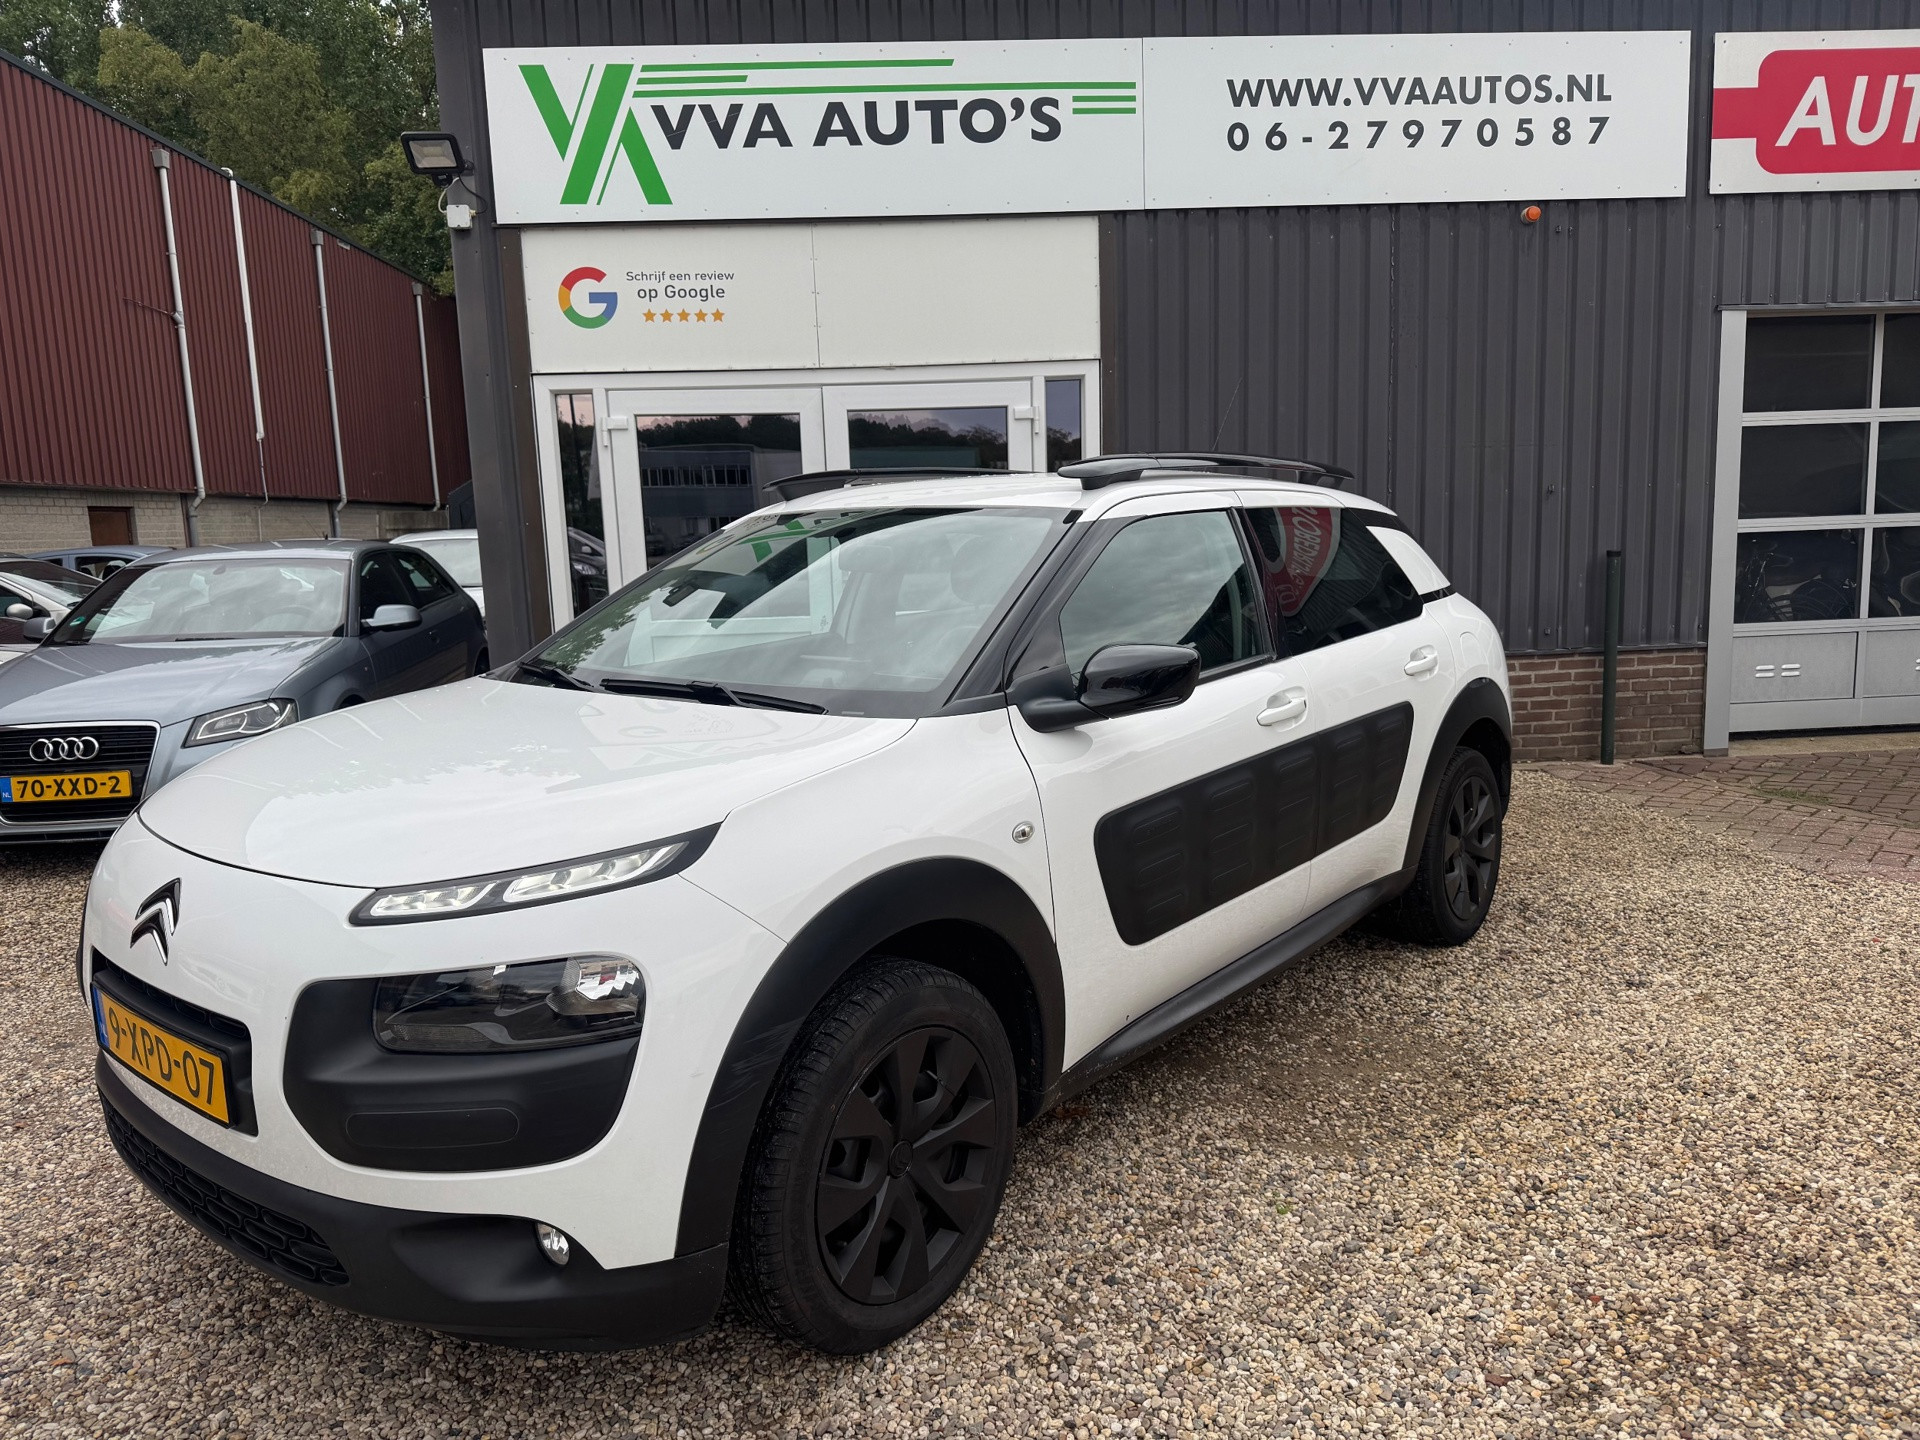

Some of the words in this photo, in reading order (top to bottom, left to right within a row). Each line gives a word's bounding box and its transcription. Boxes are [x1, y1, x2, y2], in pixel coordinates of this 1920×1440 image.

[1226, 73, 1613, 108] WWW.VVAAUTOS.NL
[651, 102, 793, 150] VVA
[812, 97, 1062, 147] AUTO'S
[1226, 116, 1611, 152] 06-27970587
[626, 271, 665, 283] Schrijf
[669, 273, 691, 281] een
[694, 270, 735, 281] review
[637, 287, 659, 302] op
[664, 284, 726, 302] Google
[16, 776, 122, 799] 70-XXD-2
[108, 1006, 215, 1106] 9-XPD-07
